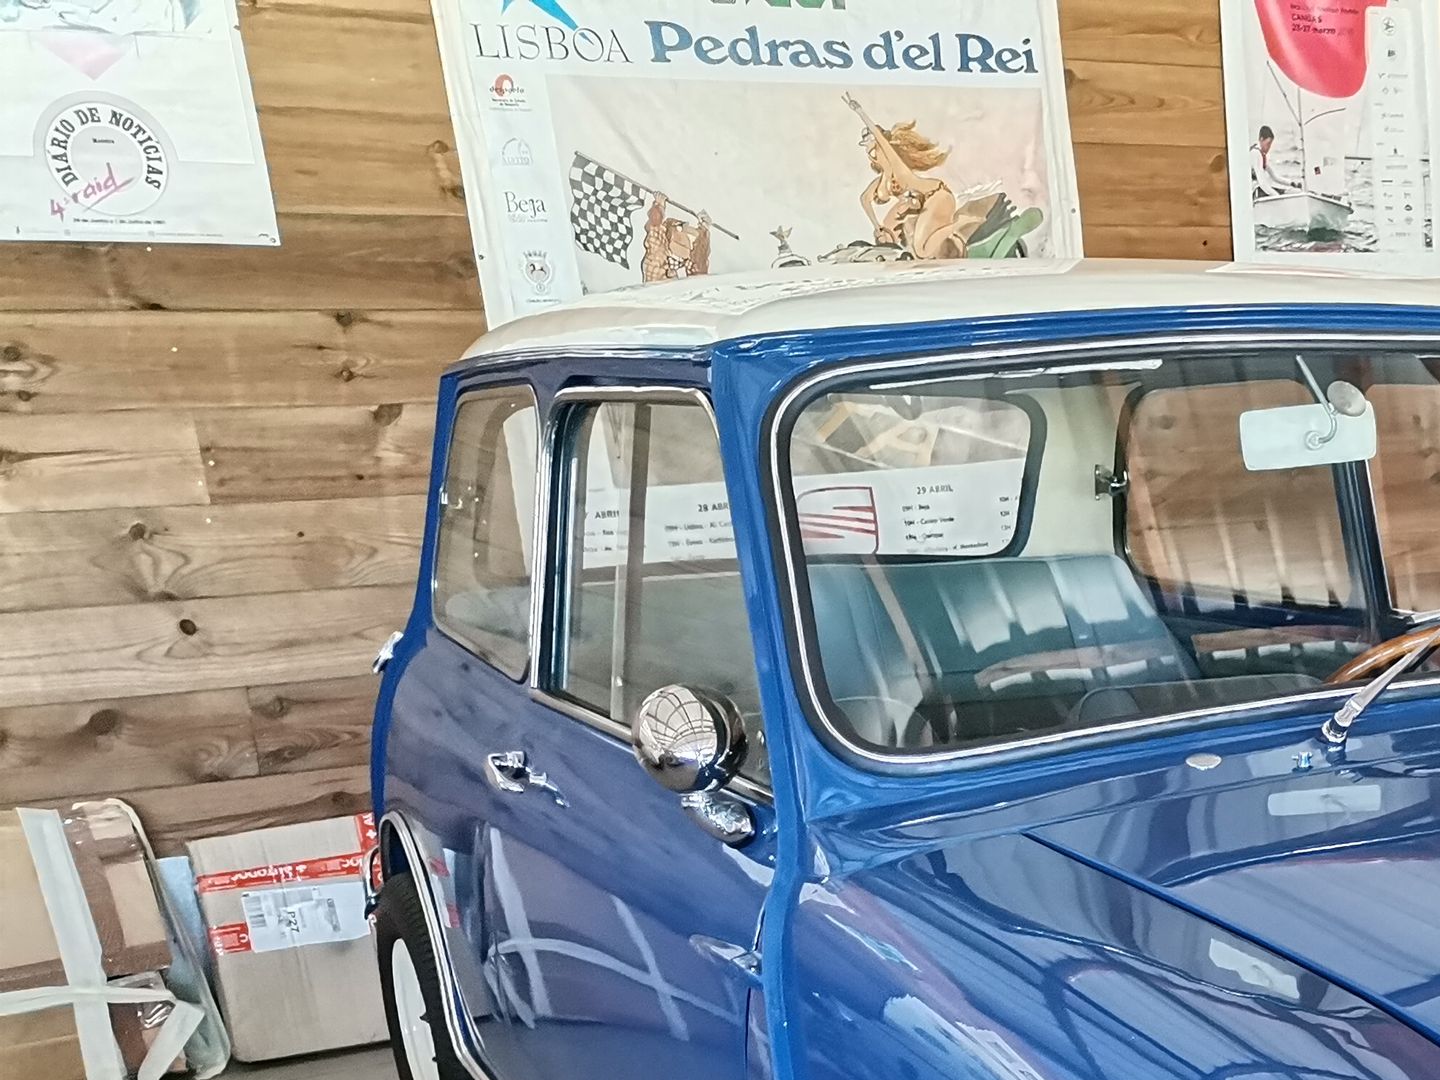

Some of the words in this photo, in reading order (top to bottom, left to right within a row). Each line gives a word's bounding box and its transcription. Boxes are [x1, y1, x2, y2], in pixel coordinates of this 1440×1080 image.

[470, 22, 634, 64] LISBOA
[644, 20, 854, 69] Pedras
[955, 33, 1038, 74] Rei
[47, 119, 79, 187] DIÁRIO
[73, 107, 101, 126] DE
[108, 109, 164, 189] NOTÍCIAS
[72, 161, 117, 204] raid
[504, 191, 547, 218] Beja
[712, 501, 730, 512] ABR
